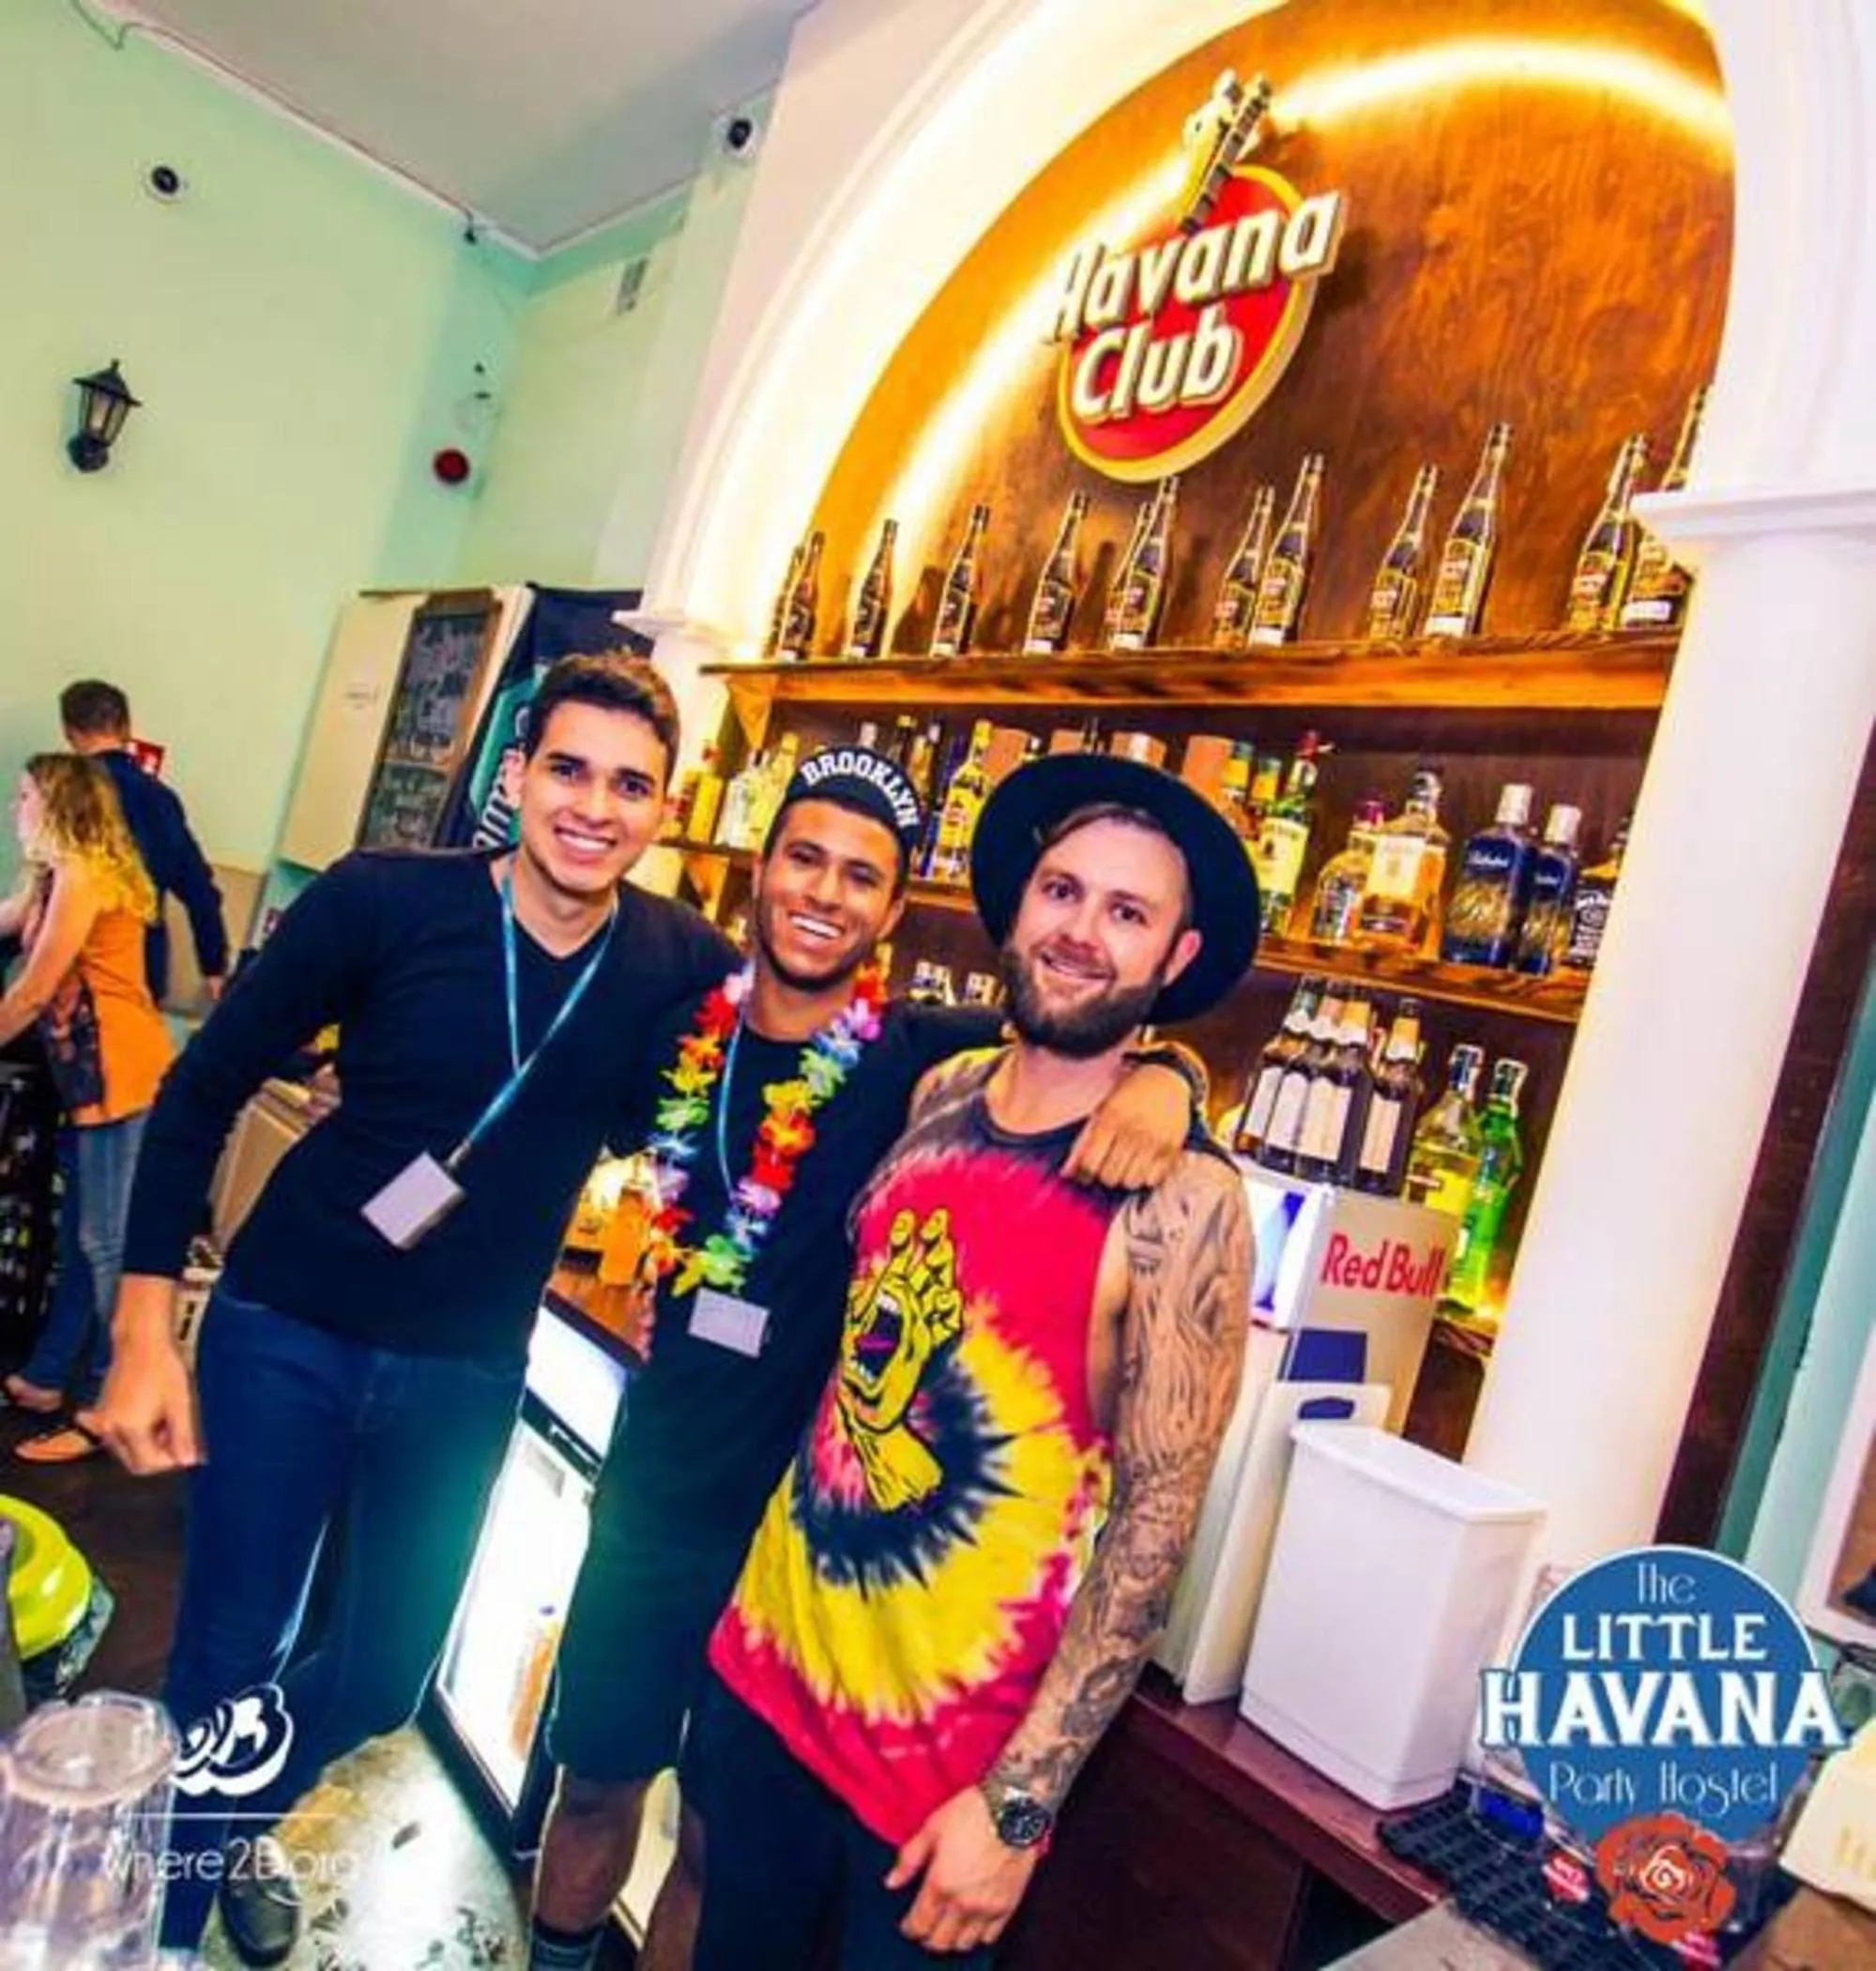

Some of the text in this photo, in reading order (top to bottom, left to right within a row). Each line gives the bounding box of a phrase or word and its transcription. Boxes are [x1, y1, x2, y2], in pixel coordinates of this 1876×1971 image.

[1049, 191, 1344, 342] Havana
[1072, 304, 1239, 421] Club
[801, 750, 920, 828] BROOKLYN
[1320, 1232, 1446, 1297] Red Bull
